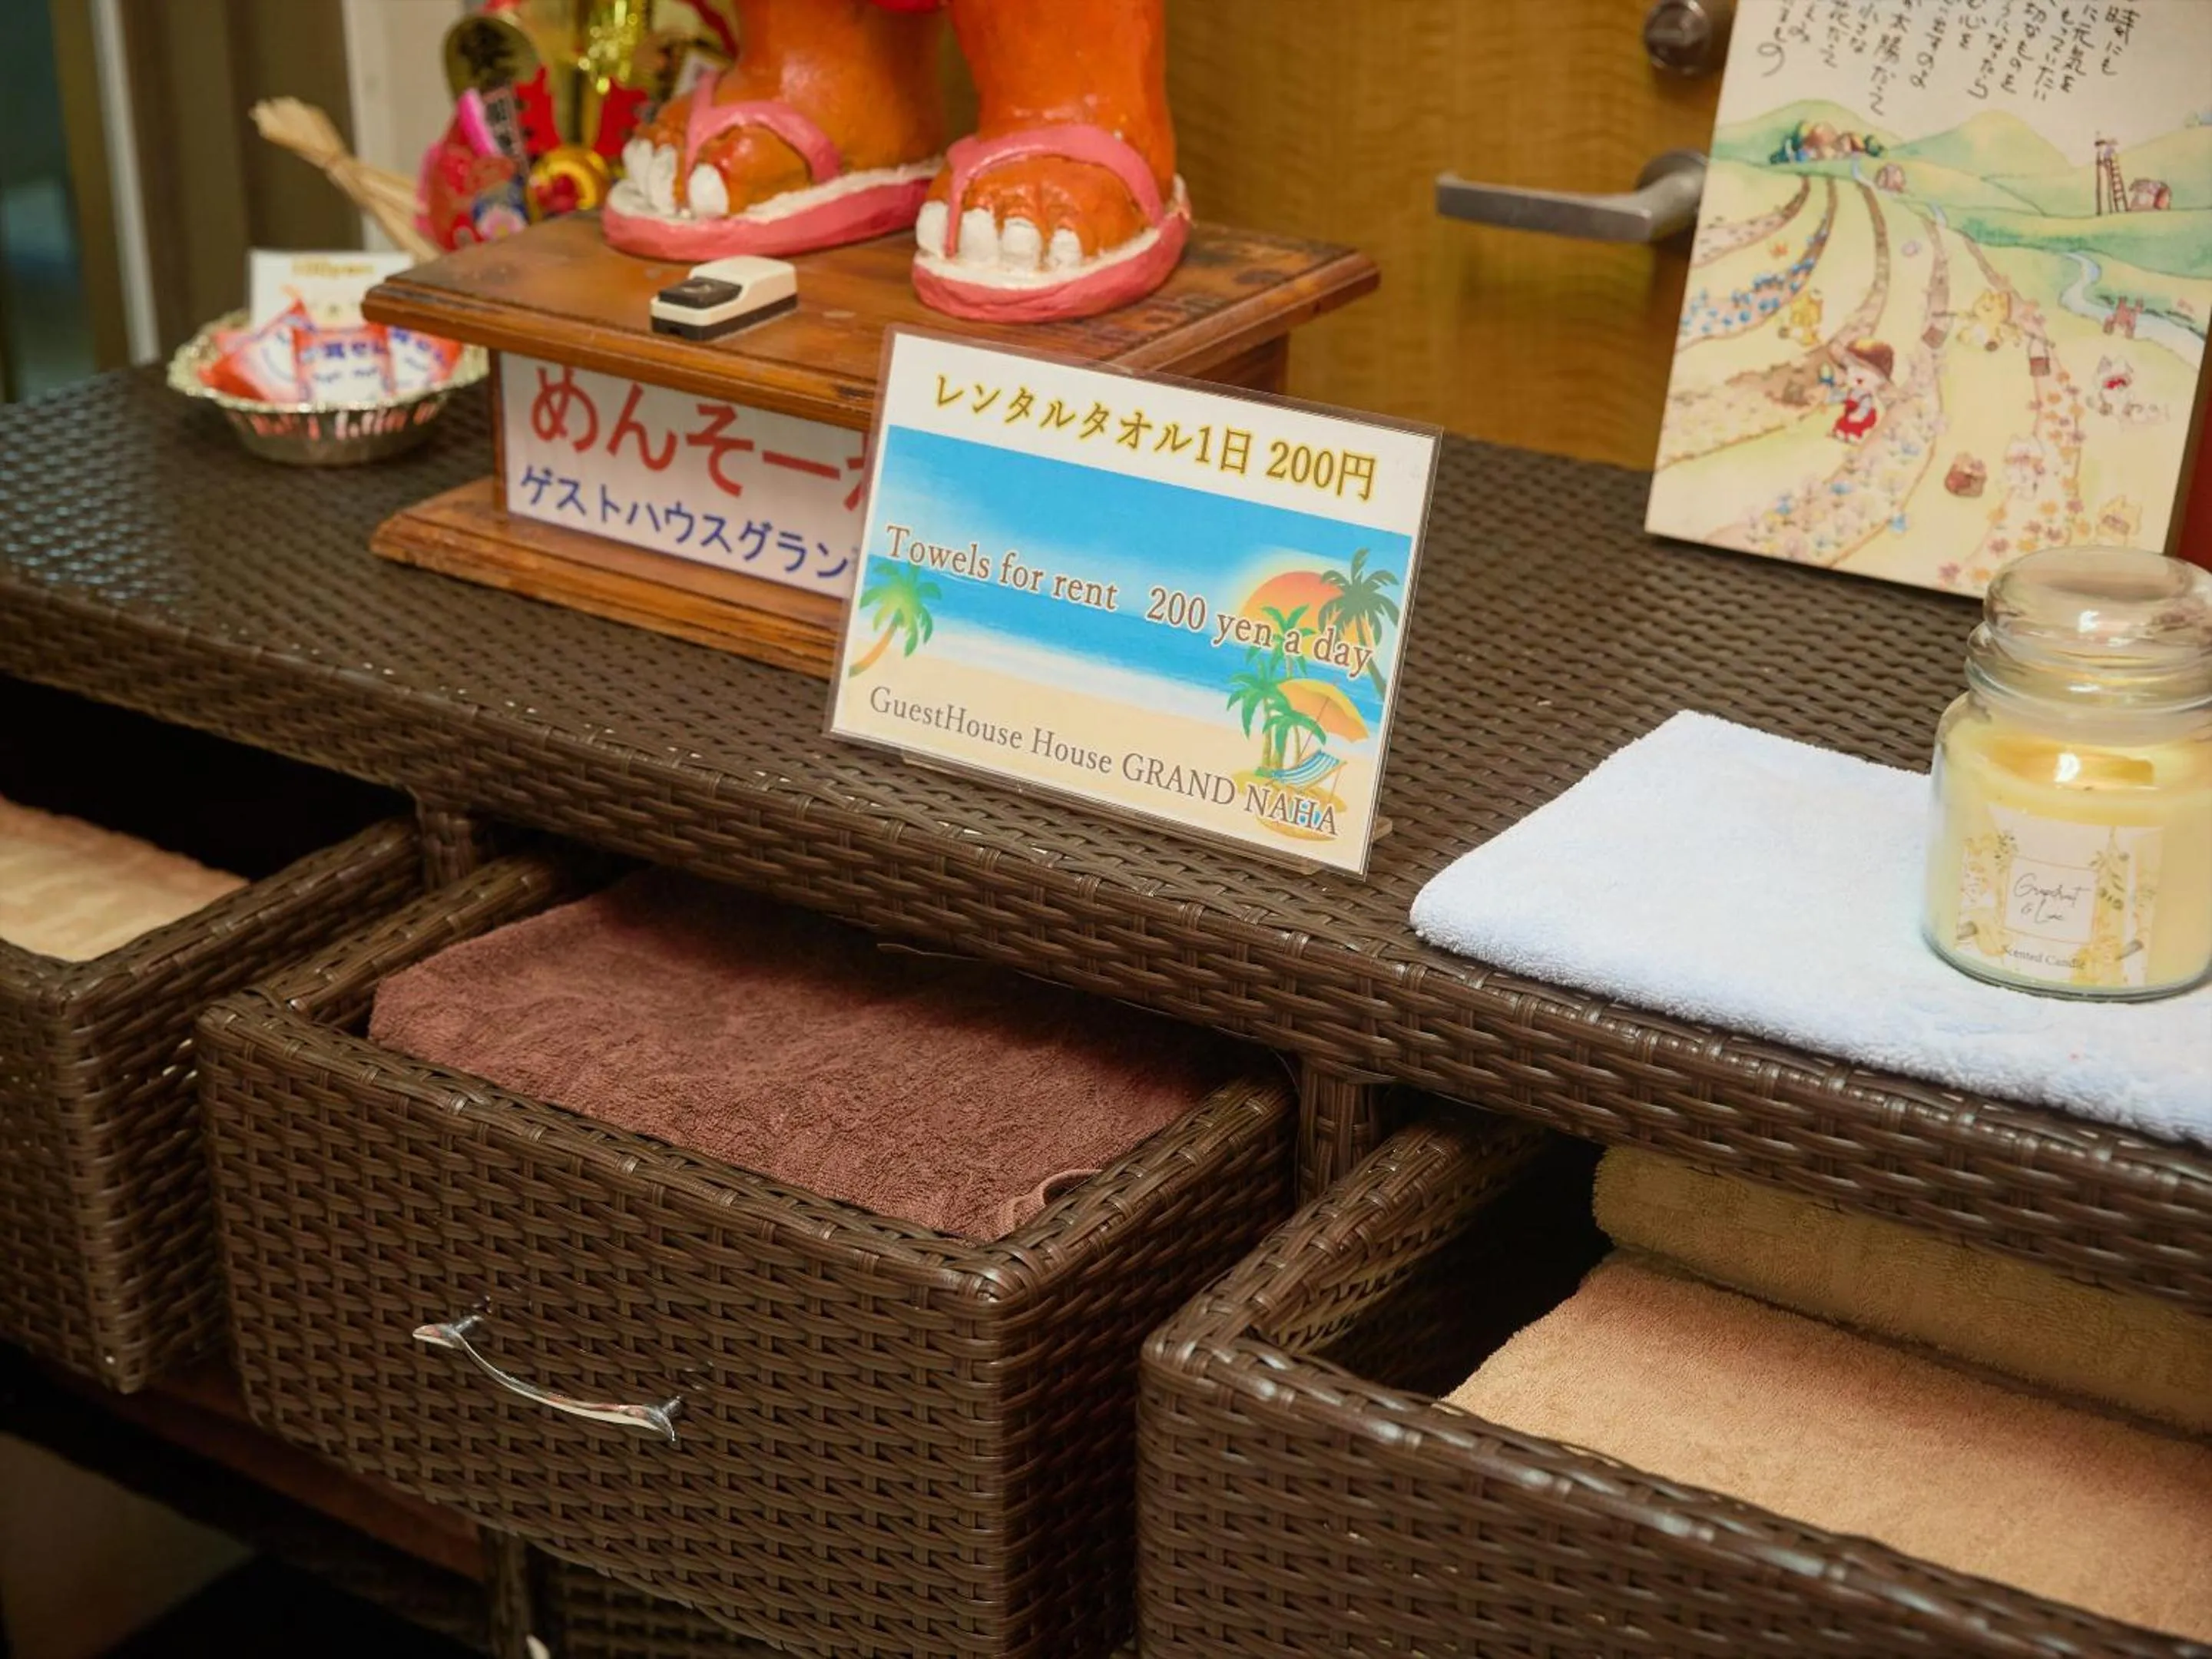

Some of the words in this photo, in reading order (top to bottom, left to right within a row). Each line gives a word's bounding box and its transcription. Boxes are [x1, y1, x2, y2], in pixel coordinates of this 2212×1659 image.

[935, 375, 1253, 475] レンタルタオル1日
[1265, 440, 1378, 502] 200円
[521, 465, 859, 580] ゲストハウスグラン
[886, 525, 991, 580] Towels
[998, 551, 1044, 591] for
[1054, 575, 1118, 611] rent
[1147, 587, 1207, 630] 200
[1212, 613, 1272, 645] yen
[1283, 629, 1301, 654] a
[1313, 626, 1373, 678] day
[869, 685, 1023, 750] GuestHouse
[1030, 727, 1113, 774] House
[1121, 752, 1237, 805] GRAND
[1246, 783, 1339, 836] NAHA
